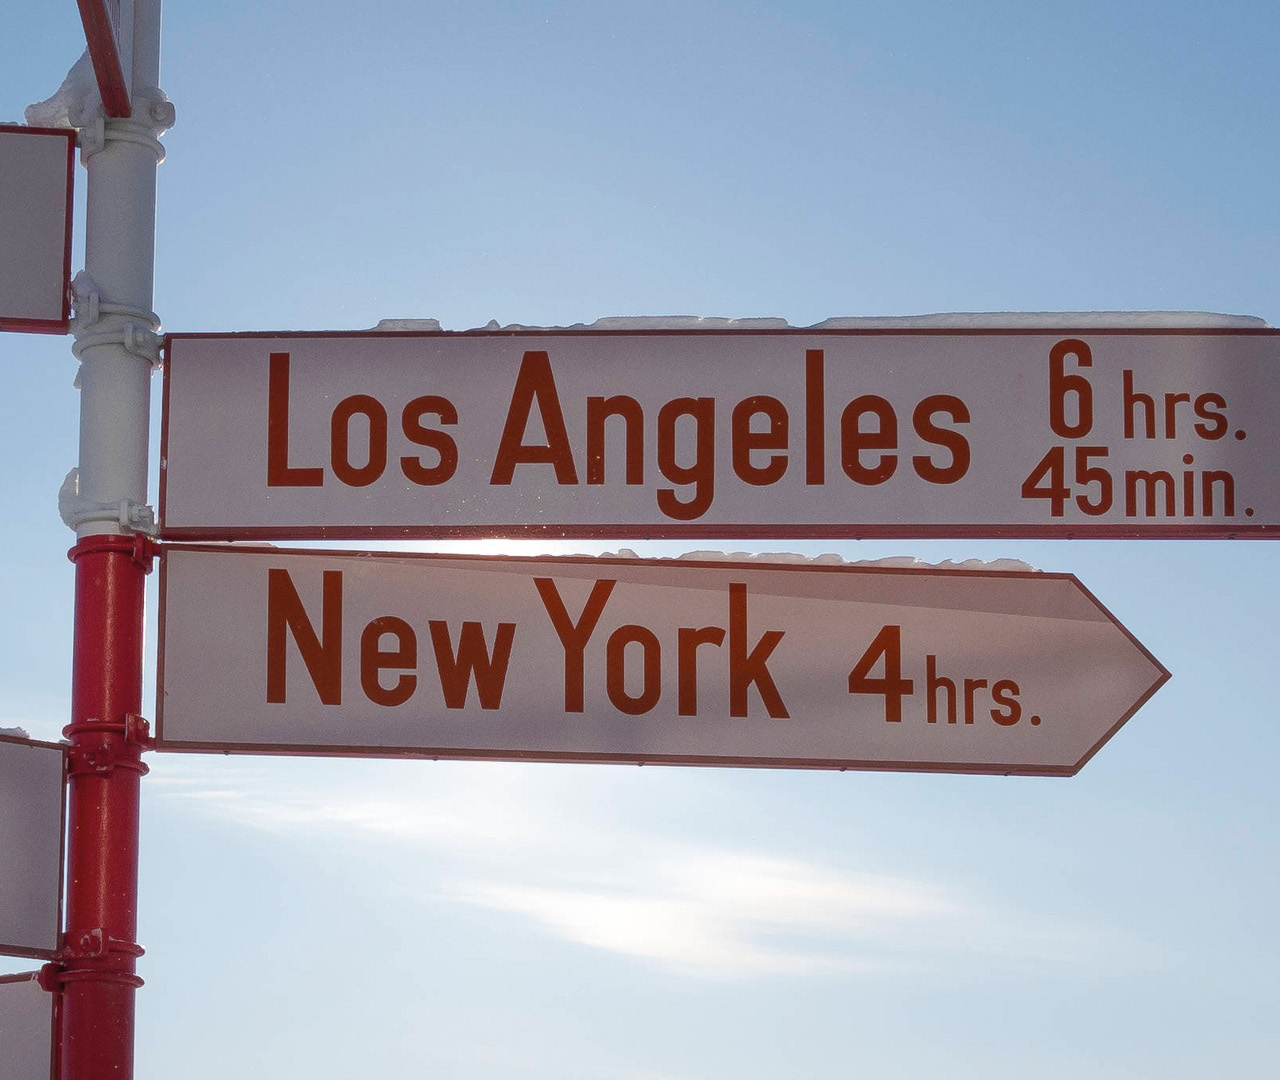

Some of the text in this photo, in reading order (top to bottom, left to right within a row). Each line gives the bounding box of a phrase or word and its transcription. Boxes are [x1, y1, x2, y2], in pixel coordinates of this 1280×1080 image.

[267, 349, 971, 521] Los Angeles
[1050, 339, 1247, 441] 6 hrs.
[1021, 446, 1255, 518] 45 min.
[267, 568, 1042, 727] New York 4 hrs.
